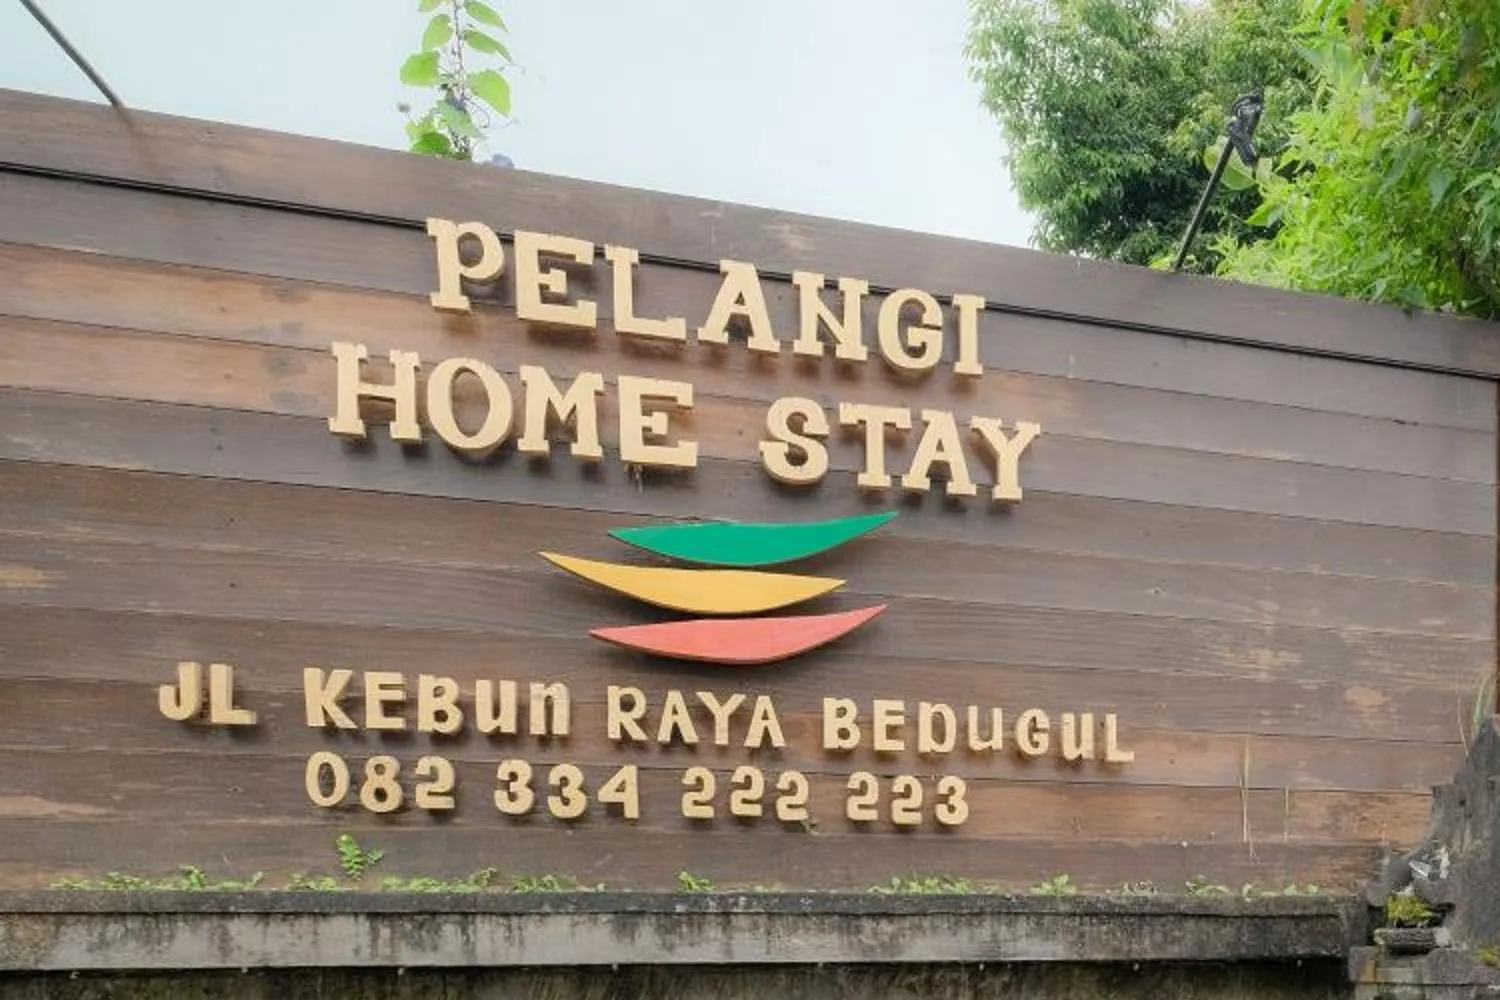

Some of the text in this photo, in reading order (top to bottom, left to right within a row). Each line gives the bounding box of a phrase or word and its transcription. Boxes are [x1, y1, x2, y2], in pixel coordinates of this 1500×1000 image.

[426, 217, 985, 377] PELANGI
[328, 341, 1041, 501] HOME STAY
[158, 661, 257, 727] JL
[607, 685, 785, 749] RAYA
[822, 696, 1135, 763] BEDUGUL
[305, 750, 969, 825] 082 334 222 223
